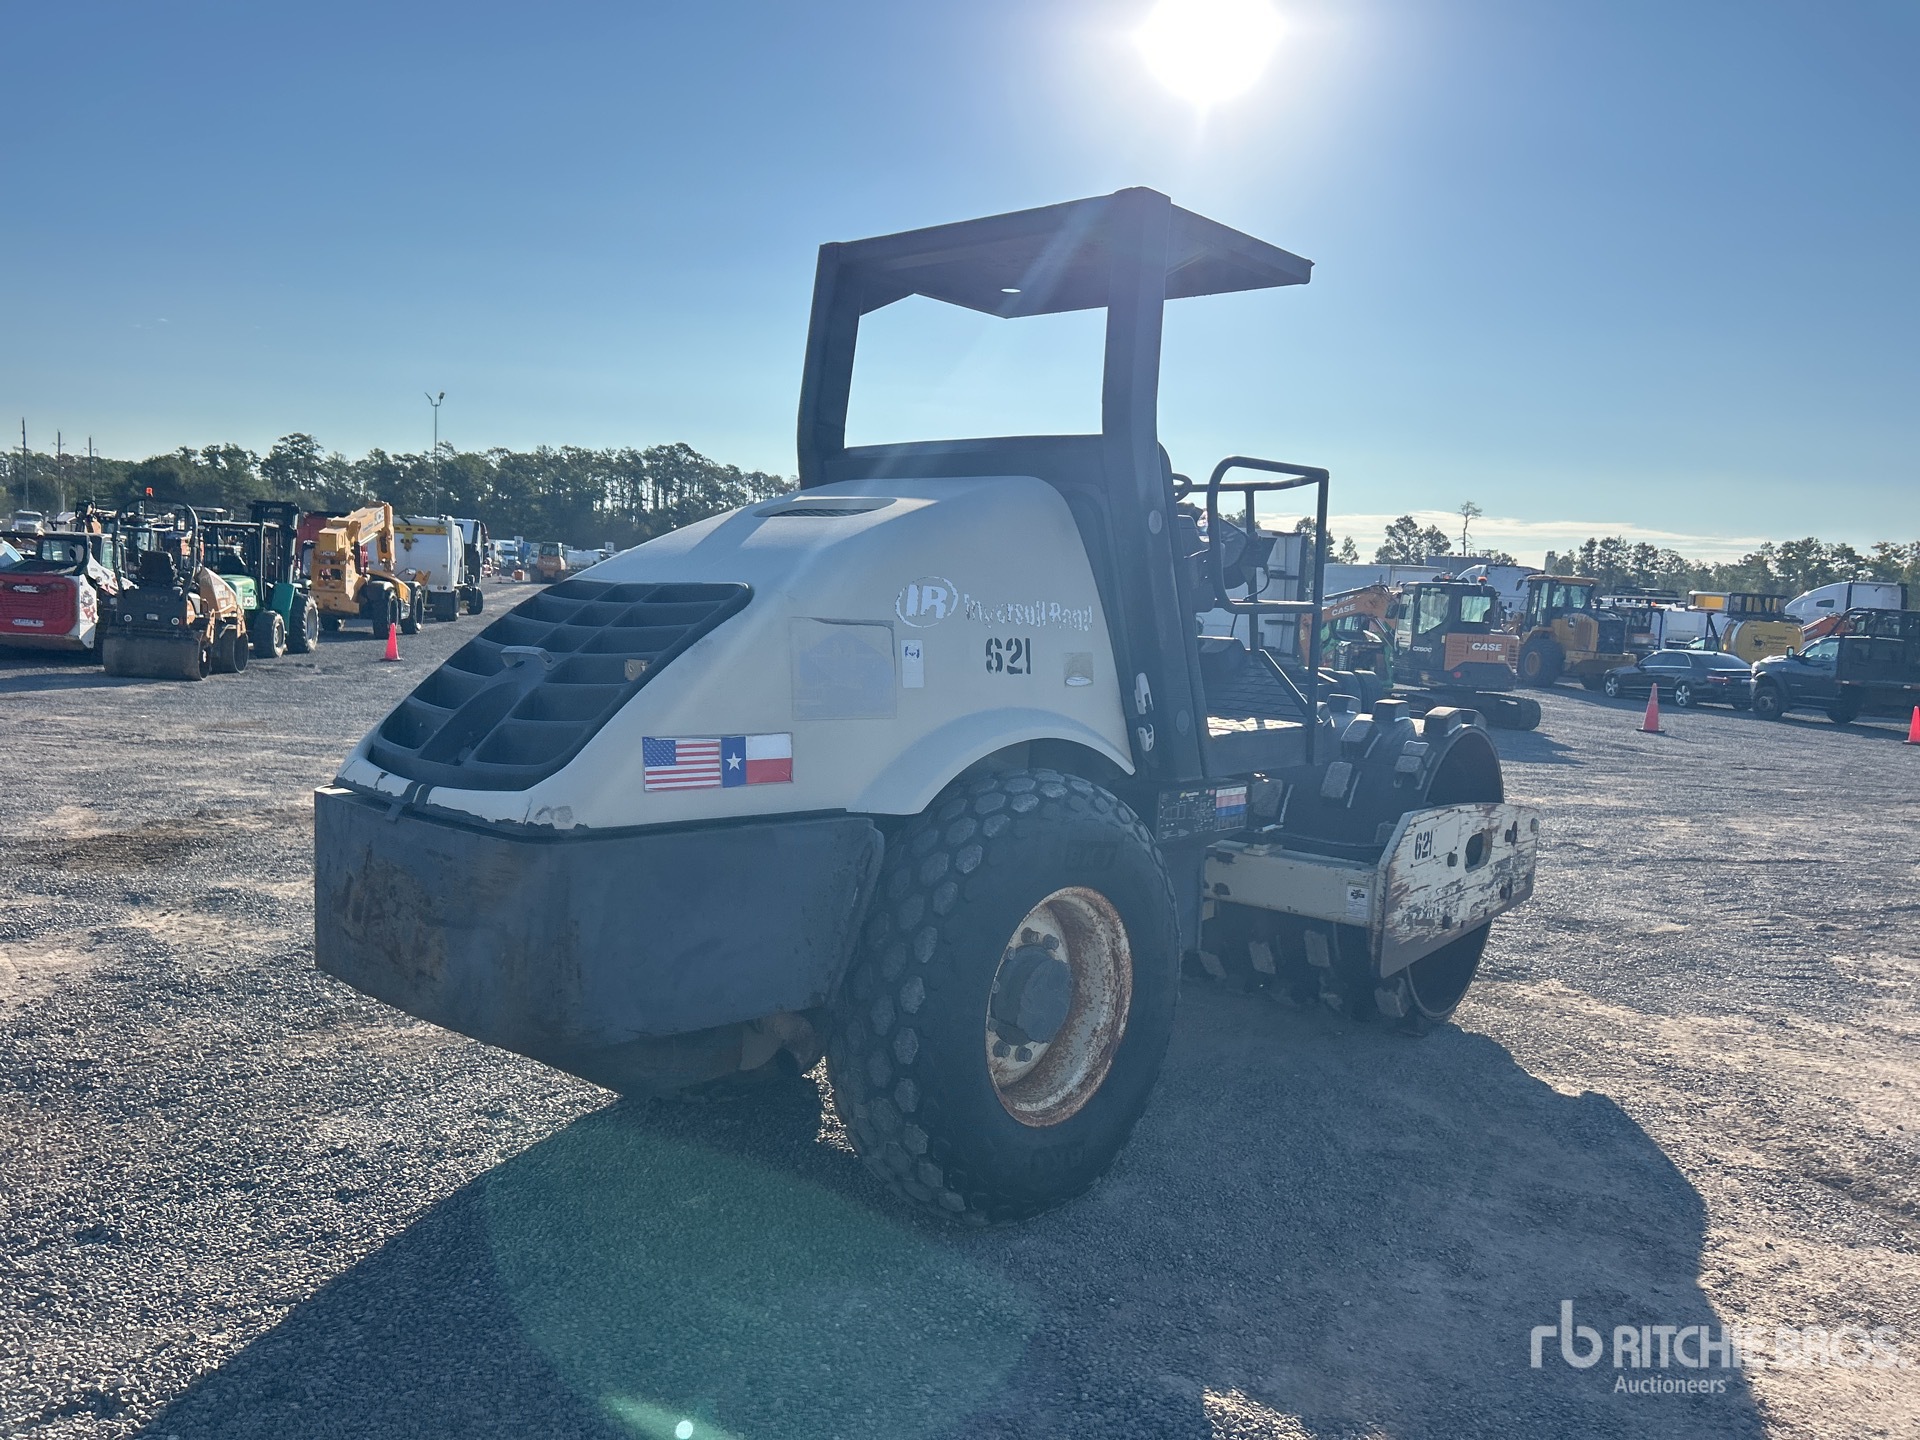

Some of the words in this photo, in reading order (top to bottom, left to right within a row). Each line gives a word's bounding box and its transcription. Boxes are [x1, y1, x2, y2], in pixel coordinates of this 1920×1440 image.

[243, 597, 255, 607] JCB
[906, 584, 948, 619] IR
[1331, 603, 1356, 616] CASE
[985, 637, 1031, 675] 621
[1471, 642, 1502, 652] CASE
[1414, 830, 1433, 860] 621
